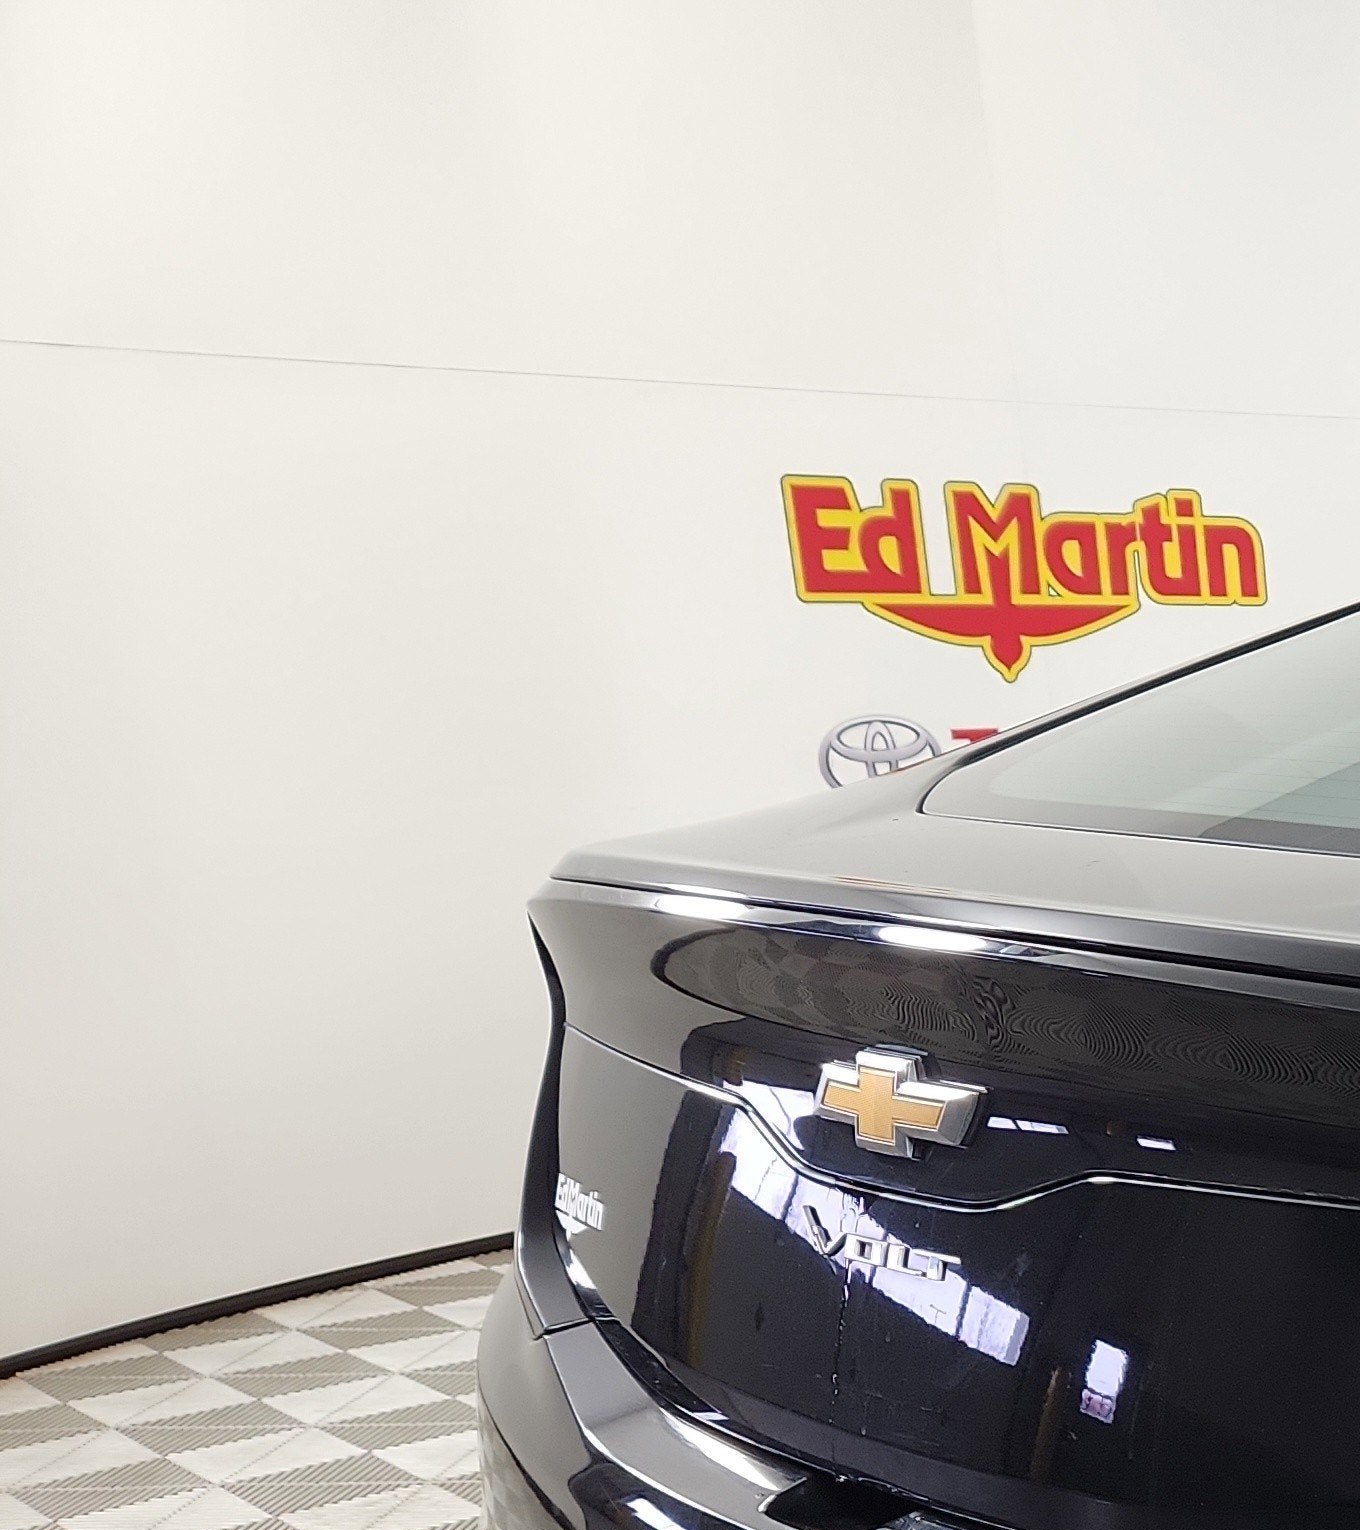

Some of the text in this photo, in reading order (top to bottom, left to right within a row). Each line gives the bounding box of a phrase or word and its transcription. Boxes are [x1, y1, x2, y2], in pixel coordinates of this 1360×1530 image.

[785, 478, 1263, 602] Ed Martin
[802, 1204, 961, 1280] VOLT
